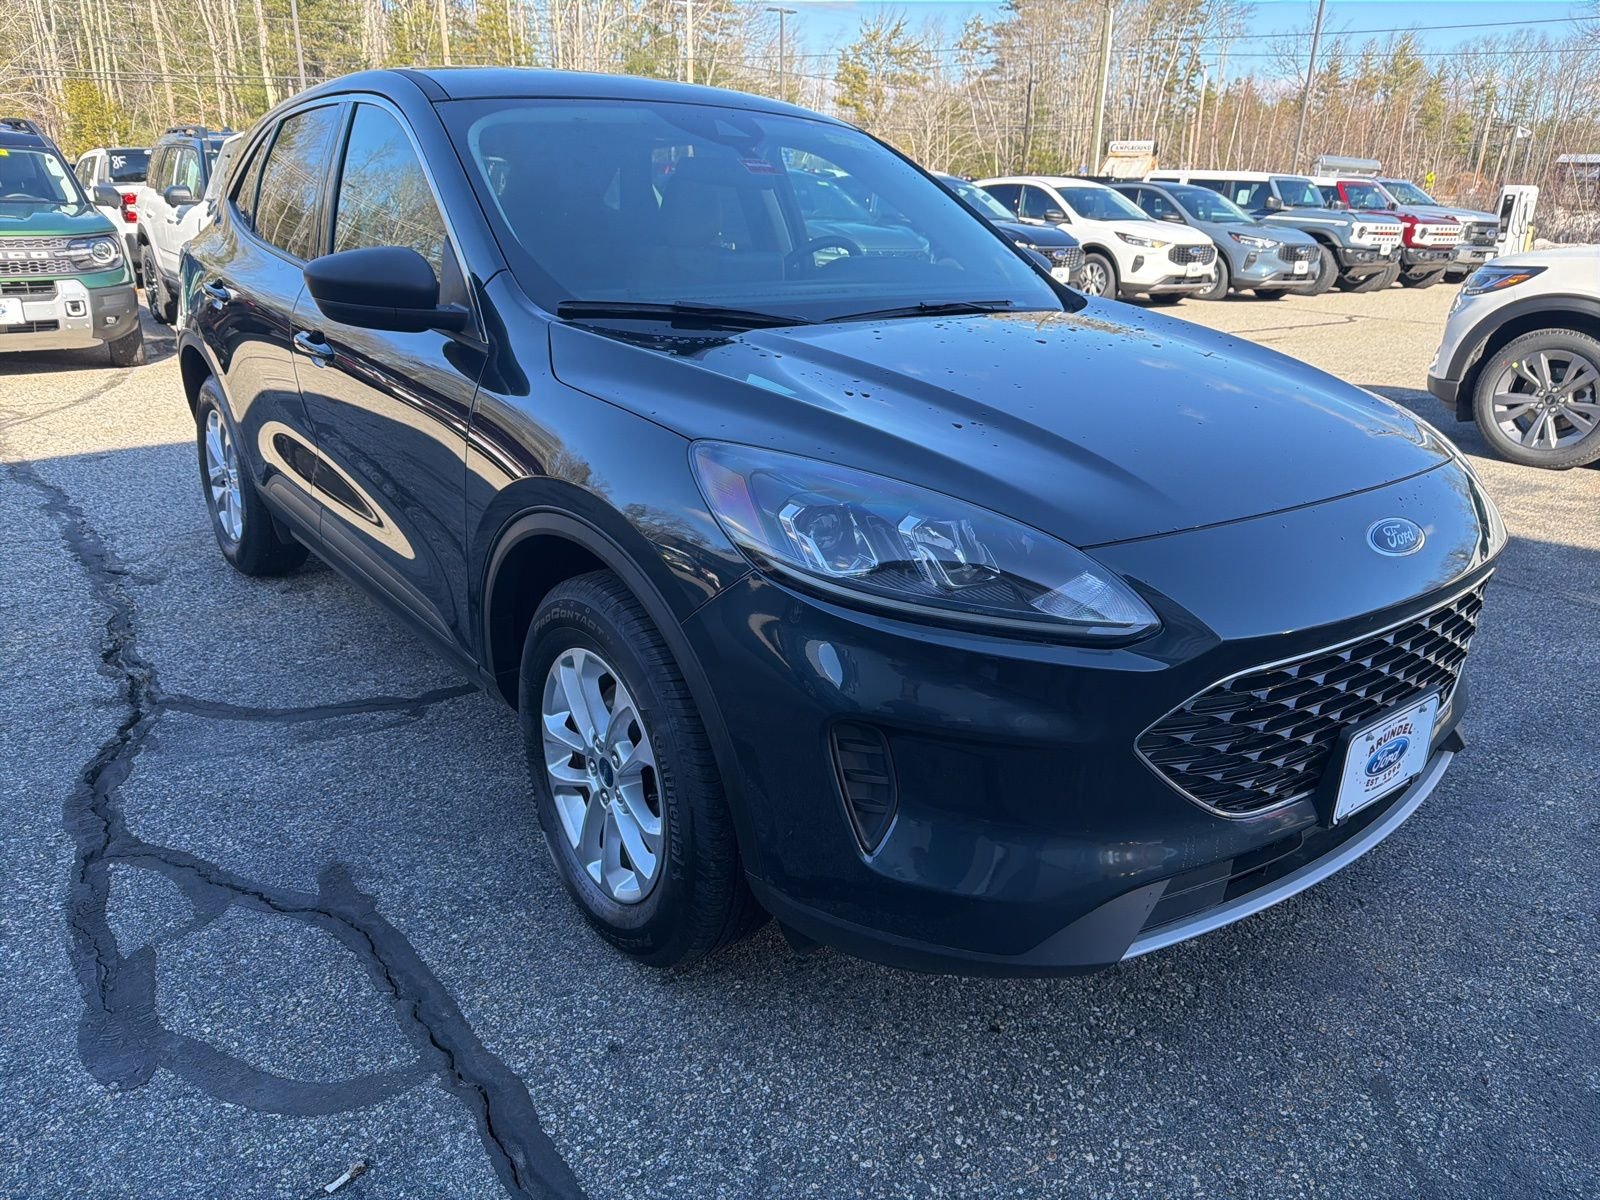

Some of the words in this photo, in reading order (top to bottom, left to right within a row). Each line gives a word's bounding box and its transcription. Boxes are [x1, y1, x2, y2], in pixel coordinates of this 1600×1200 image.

[1382, 524, 1416, 547] Ford
[1368, 723, 1413, 757] ARUNDEL
[1372, 743, 1402, 772] Ford
[1365, 778, 1379, 787] EST
